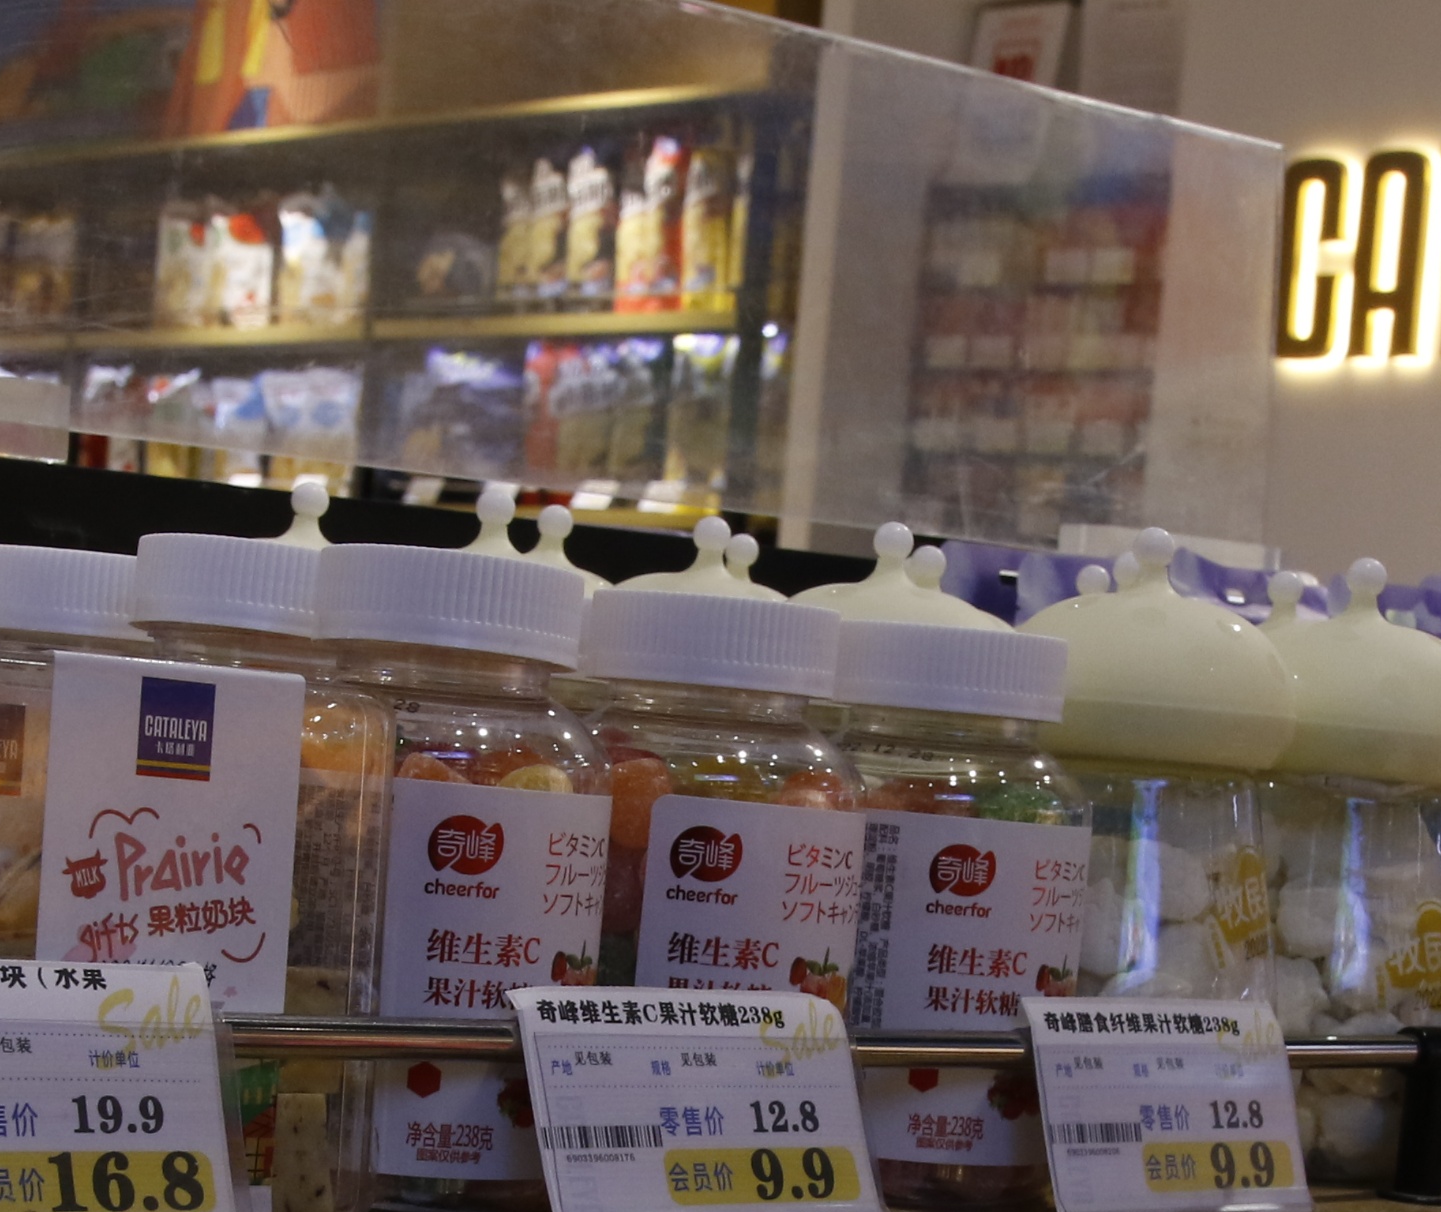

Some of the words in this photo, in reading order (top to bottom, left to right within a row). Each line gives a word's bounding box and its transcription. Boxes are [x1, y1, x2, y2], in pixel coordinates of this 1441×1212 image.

[144, 714, 208, 744] CATALEYA
[436, 828, 497, 864] 奇峰
[677, 838, 735, 872] 奇峰
[72, 861, 101, 888] MILK
[113, 830, 251, 902] Prairie
[936, 855, 990, 886] 奇峰
[424, 878, 500, 900] cheerfor
[666, 885, 738, 906] cheerfor
[146, 897, 256, 937] 果粒奶块
[925, 900, 993, 919] cheerfor
[79, 911, 140, 963] gifts
[426, 928, 541, 968] 维生素C
[667, 931, 780, 971] 维生素C
[926, 943, 1028, 978] 维生素C
[536, 999, 785, 1030] 奇峰维生素C果汁软糖238g
[925, 984, 1021, 1016] 果汁软糖
[1043, 1011, 1240, 1036] 奇峰膳食纤维果汁软糖238g
[88, 1050, 141, 1070] 计价单位
[573, 1051, 613, 1067] 见包装
[680, 1052, 717, 1068] 见包装
[70, 1095, 164, 1135] 19.9
[659, 1107, 725, 1137] 零售价
[749, 1100, 820, 1134] 12.8
[1139, 1104, 1190, 1131] 零售价
[1209, 1099, 1264, 1129] 12.8
[47, 1151, 205, 1212] 16.8
[668, 1162, 734, 1192] 会员价
[751, 1148, 835, 1200] 9.9
[1145, 1153, 1197, 1180] 会员价
[1210, 1141, 1276, 1189] 9.9
